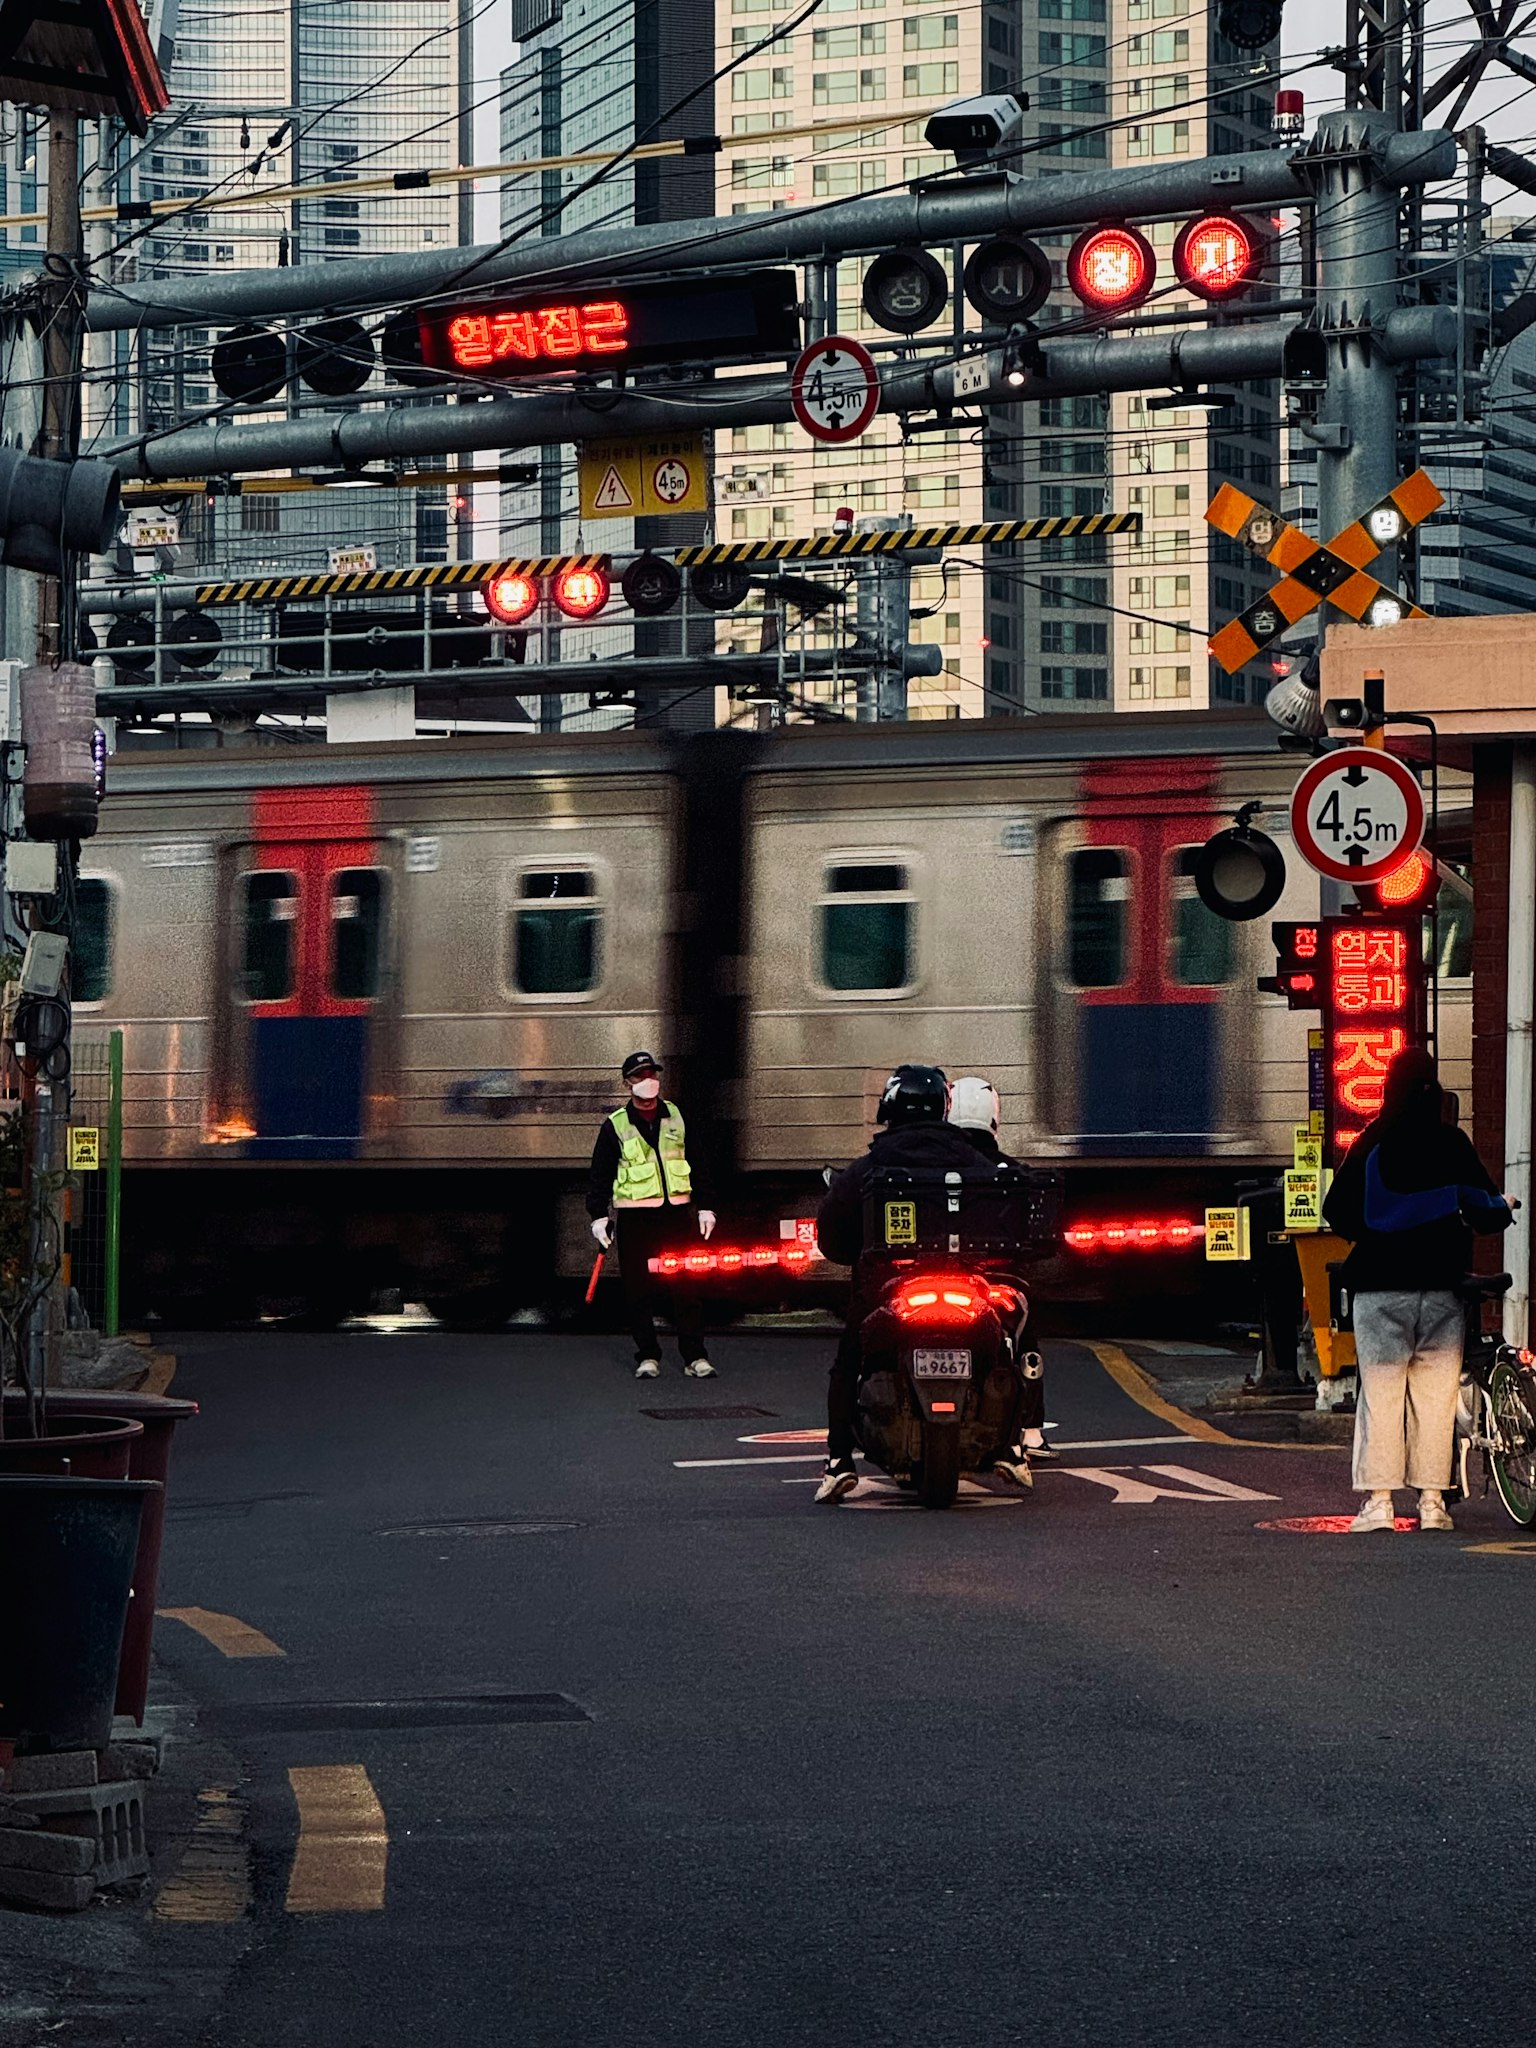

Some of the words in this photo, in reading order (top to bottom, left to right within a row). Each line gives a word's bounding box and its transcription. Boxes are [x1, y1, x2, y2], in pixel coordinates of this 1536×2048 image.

[1093, 250, 1130, 289] 정
[1199, 238, 1236, 276] 지
[450, 302, 628, 365] 열차접근
[808, 369, 862, 411] 4.5m
[961, 378, 969, 390] 6
[972, 374, 982, 388] M
[1316, 790, 1397, 842] 4.5m
[1336, 931, 1407, 968] 열차
[1336, 973, 1407, 1009] 통과
[889, 1218, 912, 1231] 주차
[930, 1360, 967, 1375] 9667
